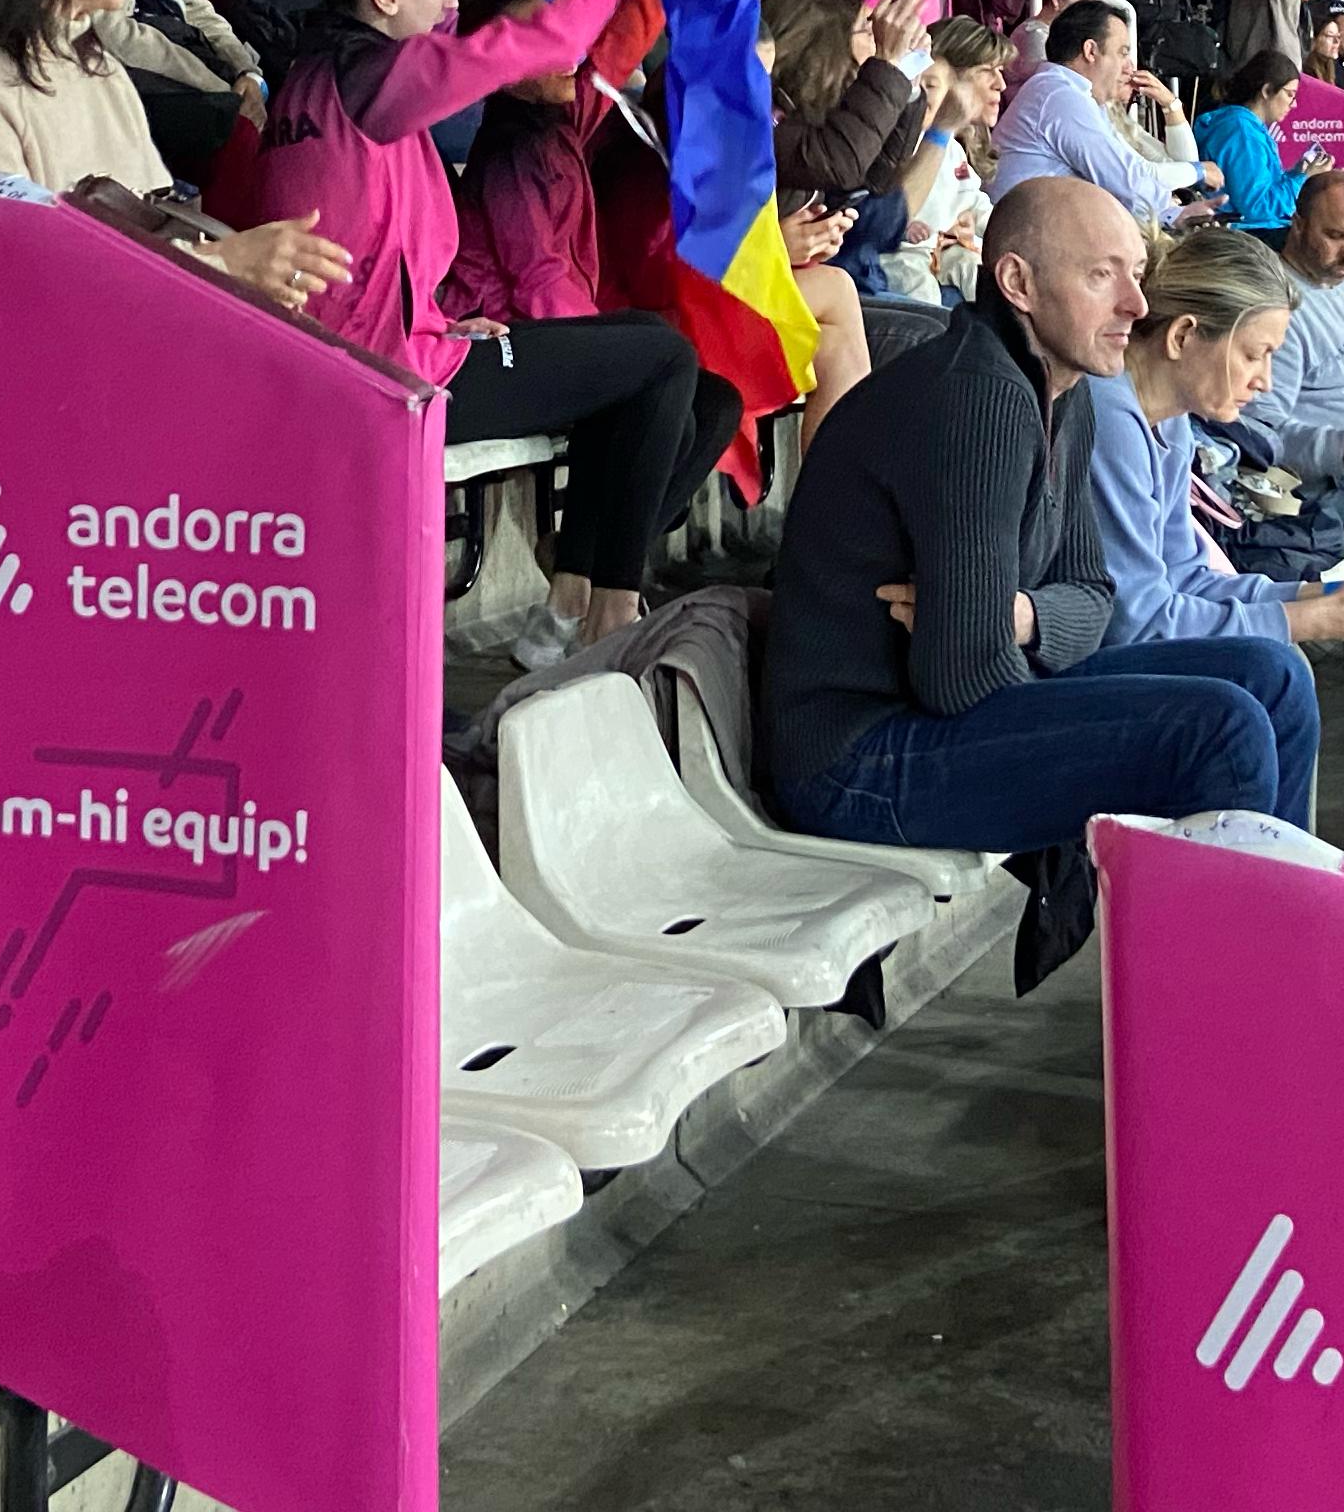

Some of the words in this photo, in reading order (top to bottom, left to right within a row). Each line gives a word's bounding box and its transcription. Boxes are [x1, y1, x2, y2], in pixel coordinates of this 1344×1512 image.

[1292, 118, 1344, 130] andorra
[67, 493, 306, 557] andorra
[67, 563, 317, 632] telecom
[142, 800, 308, 871] equip!
